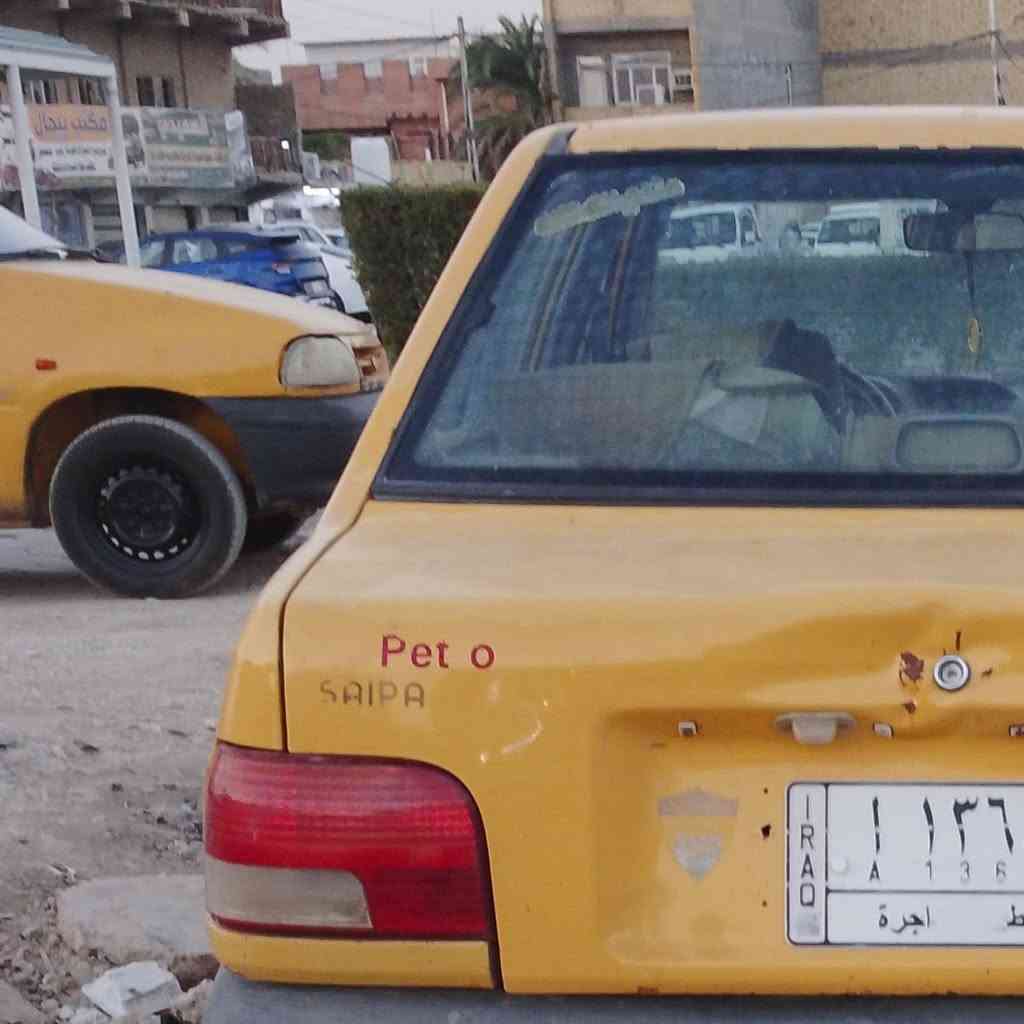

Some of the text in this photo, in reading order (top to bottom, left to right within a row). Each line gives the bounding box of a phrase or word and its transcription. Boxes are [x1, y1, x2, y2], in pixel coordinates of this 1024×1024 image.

[319, 680, 425, 708] SAIPA
[799, 795, 816, 907] IRAQ
[878, 903, 931, 934] اجرة
